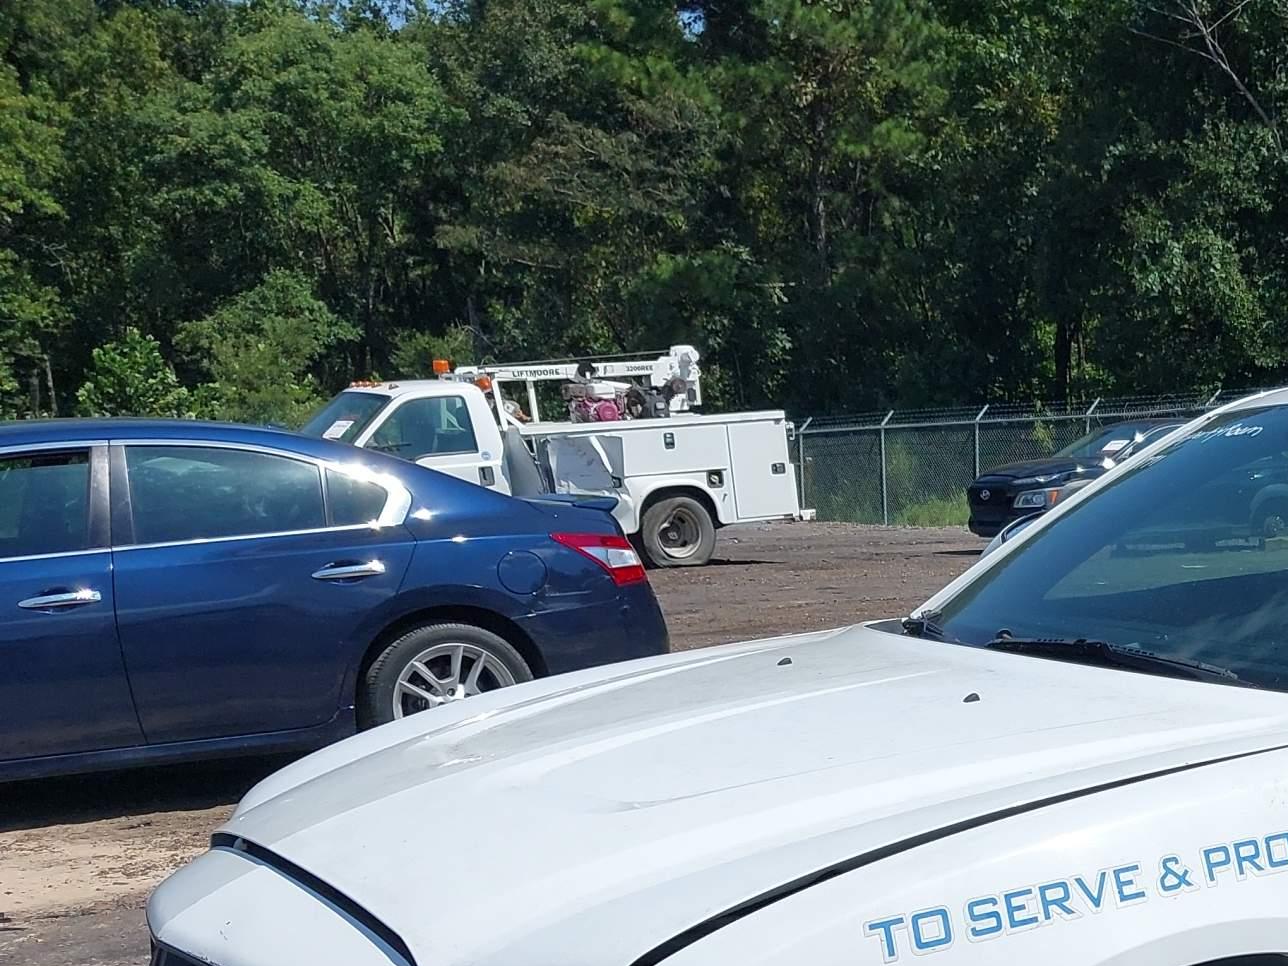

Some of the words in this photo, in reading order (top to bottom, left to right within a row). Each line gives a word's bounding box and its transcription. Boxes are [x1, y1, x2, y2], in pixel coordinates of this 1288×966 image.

[512, 368, 560, 378] LIFTMOORE
[868, 908, 952, 958] TO
[969, 864, 1146, 937] SERVE
[1160, 855, 1194, 890] &
